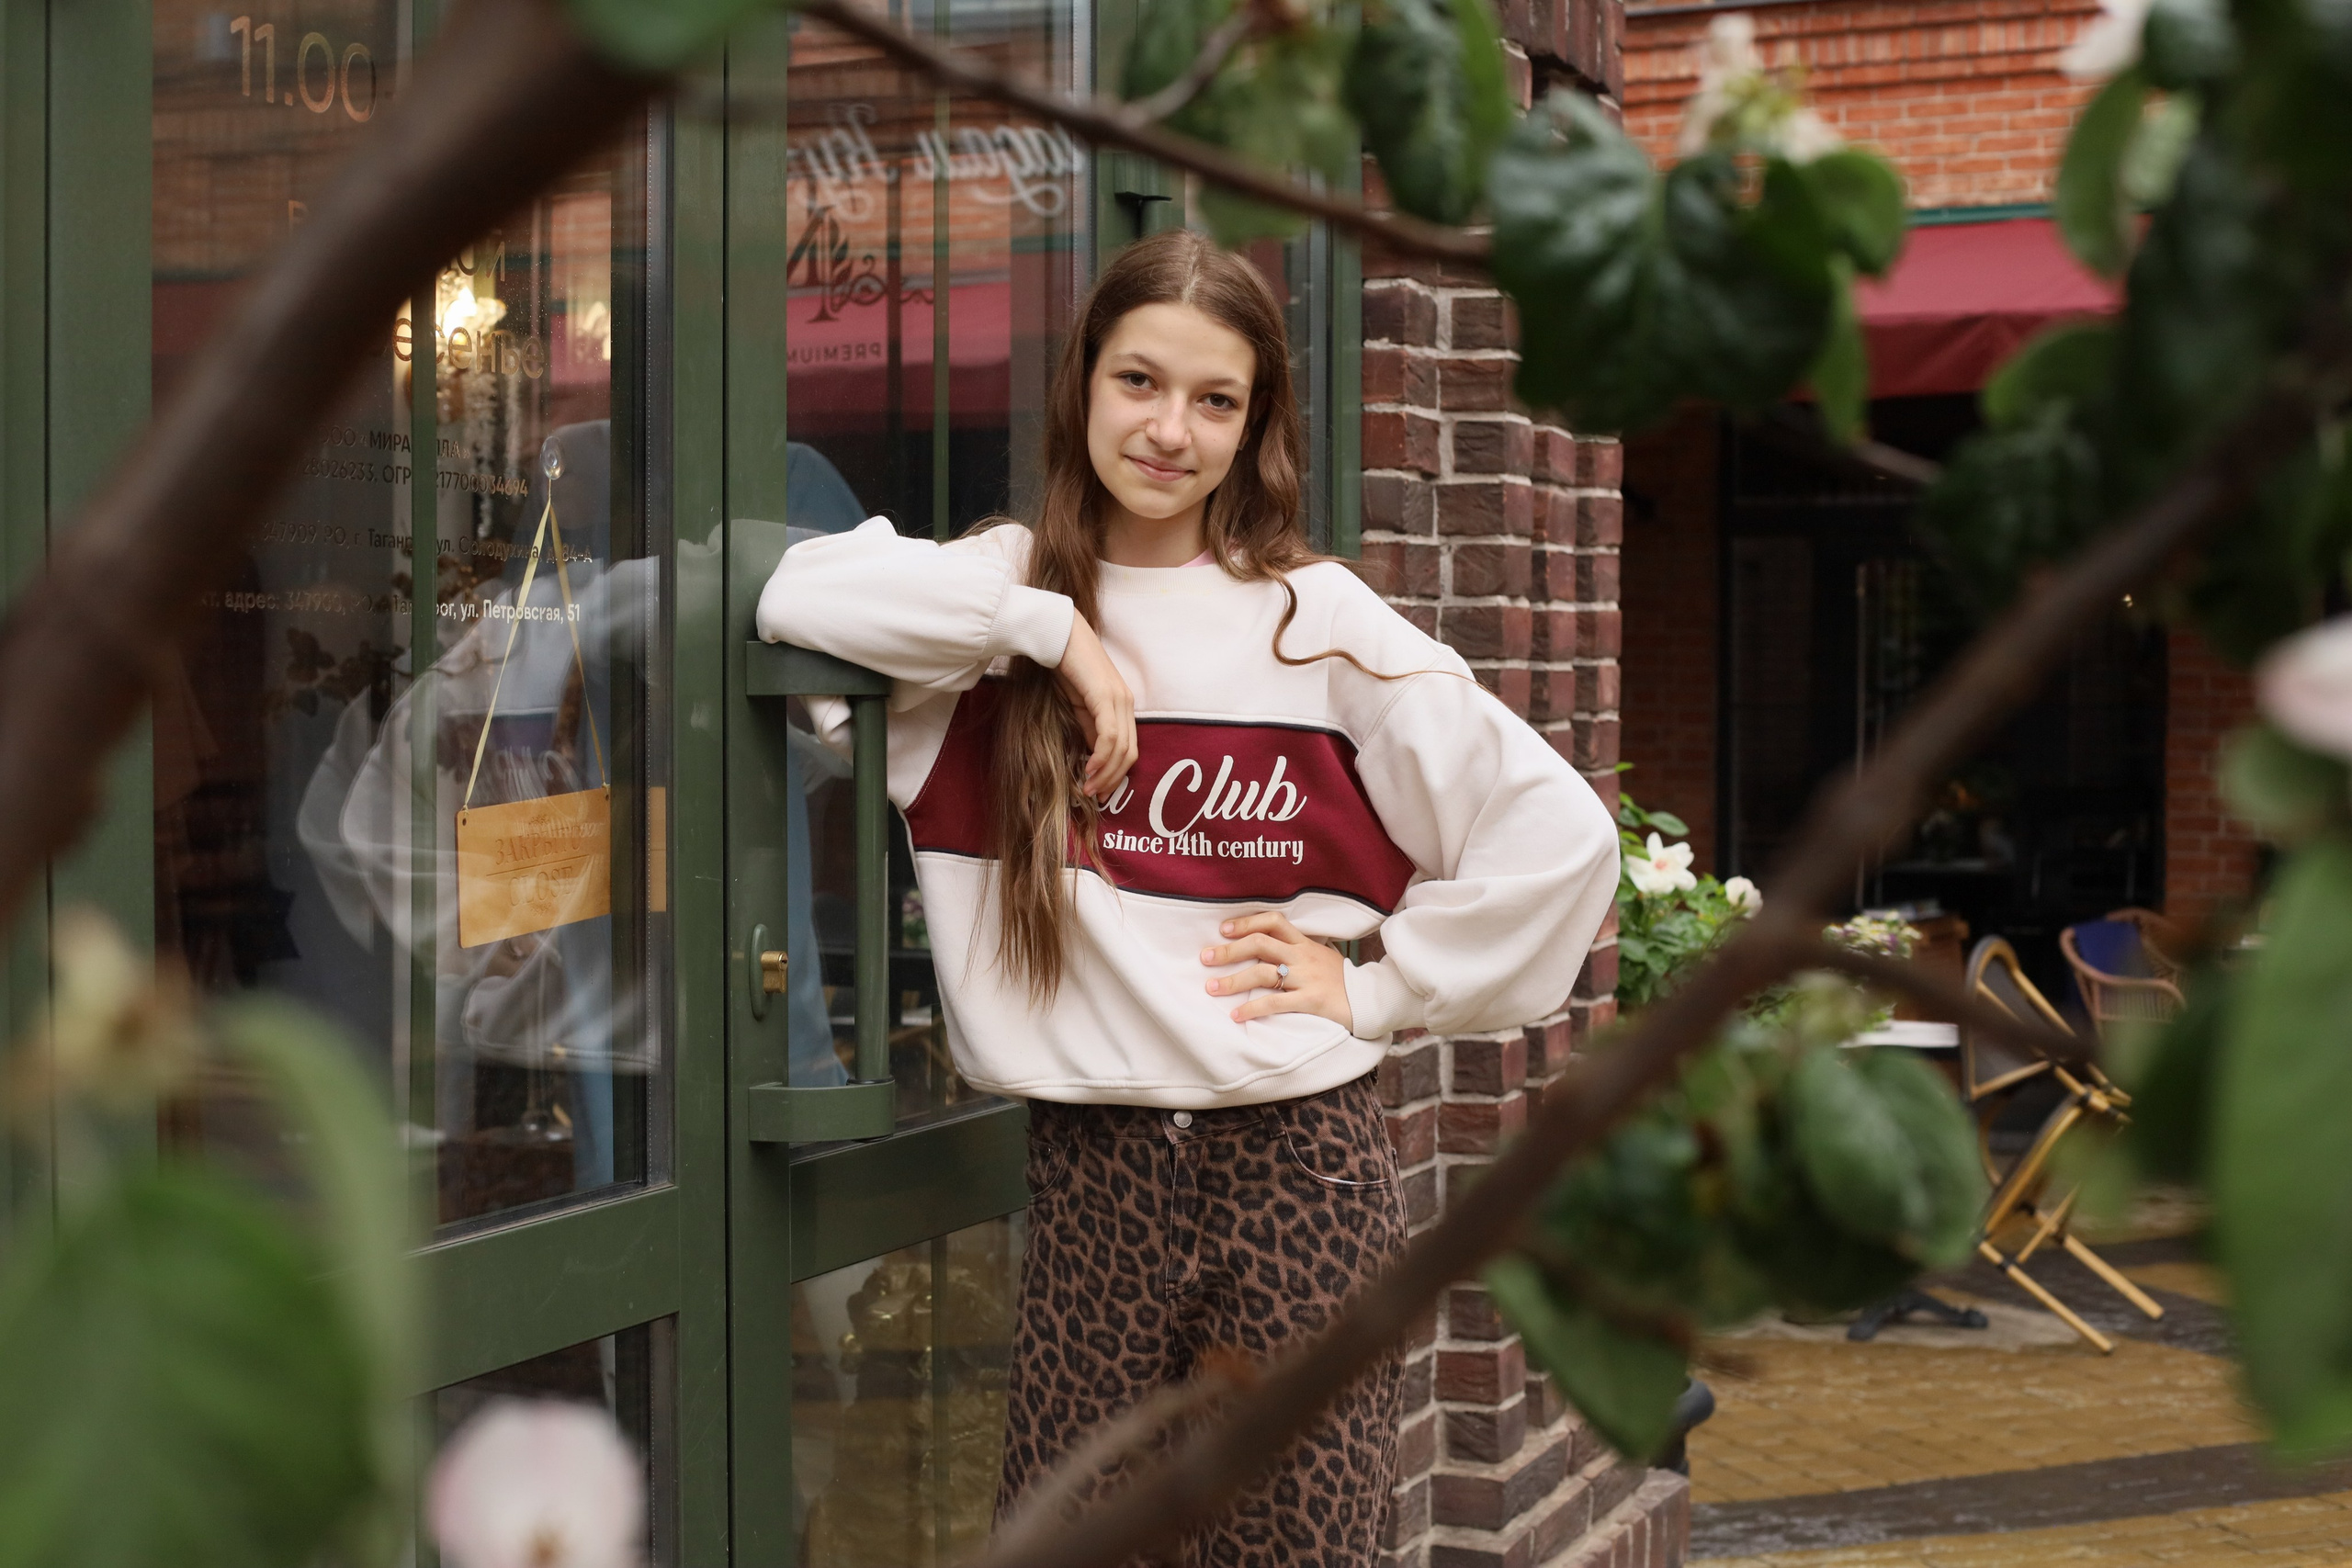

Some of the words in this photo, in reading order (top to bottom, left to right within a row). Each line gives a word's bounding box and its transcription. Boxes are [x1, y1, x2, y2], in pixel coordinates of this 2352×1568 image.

[383, 465, 412, 485] ОГР
[460, 604, 479, 622] ул.
[483, 599, 564, 624] Петровская,
[567, 603, 581, 622] 51
[1148, 755, 1307, 839] Club
[495, 825, 581, 865] ЗАКРЫТО
[1102, 829, 1163, 855] since
[1167, 830, 1213, 857] 14th
[1217, 834, 1304, 865] century
[508, 865, 573, 907] CLOSE
